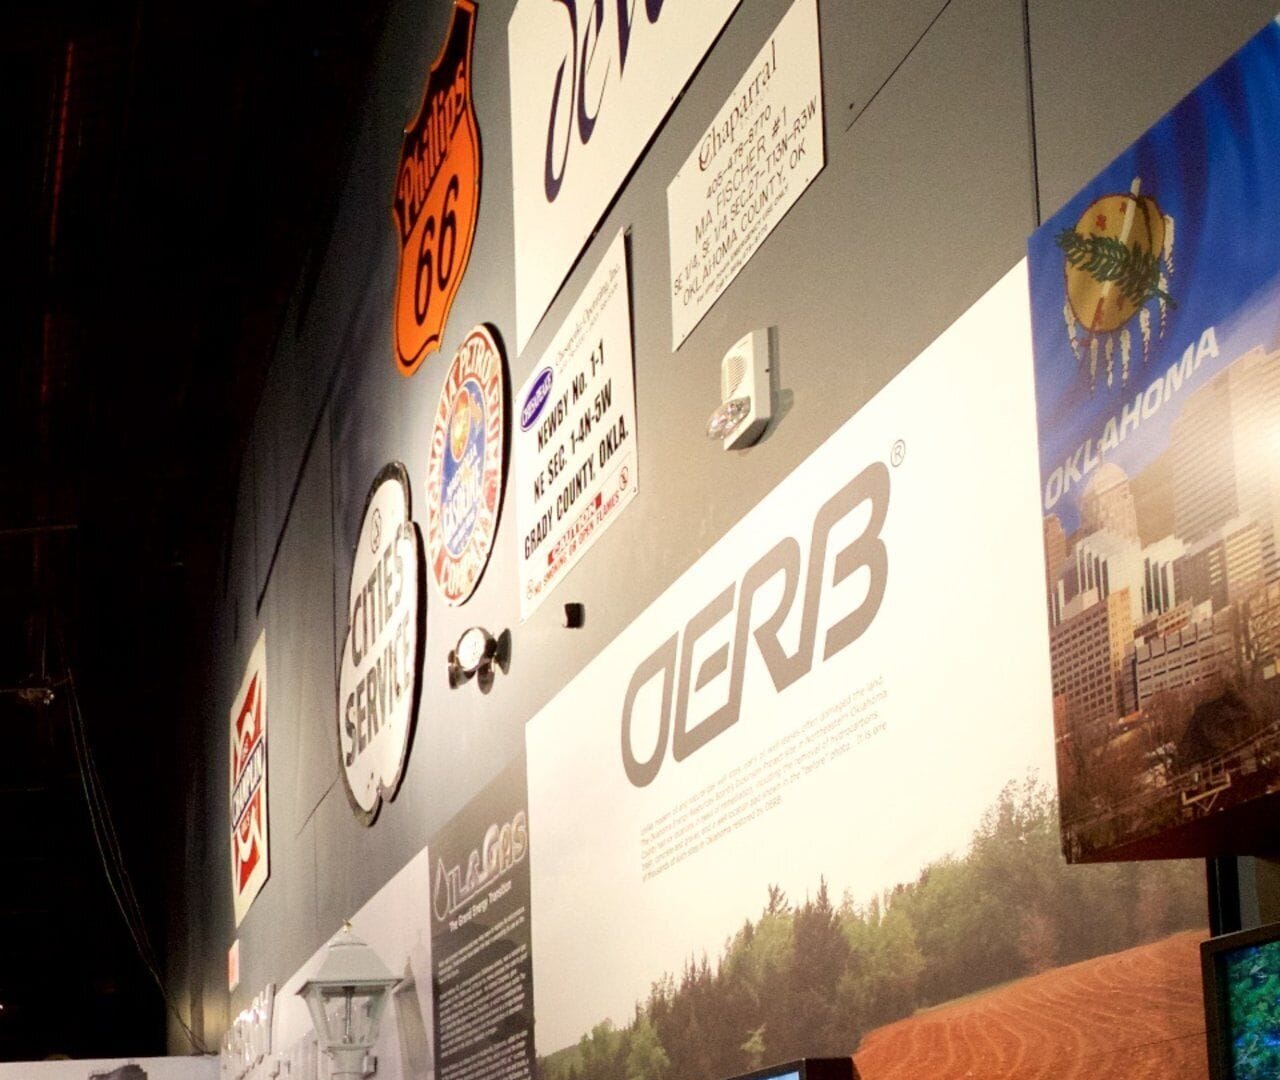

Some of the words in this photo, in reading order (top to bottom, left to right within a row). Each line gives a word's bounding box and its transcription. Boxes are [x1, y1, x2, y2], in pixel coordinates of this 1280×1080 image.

[399, 61, 465, 233] Phillips
[694, 209, 713, 245] MA
[716, 135, 767, 217] FISCHER
[772, 105, 787, 141] #1
[698, 40, 778, 173] Chaparral
[414, 173, 460, 327] 66
[683, 230, 738, 307] OKLAHOMA
[789, 138, 807, 171] OK
[533, 471, 544, 503] NE
[569, 378, 612, 455] 1-4N-5W
[536, 390, 569, 453] NEWBY
[589, 337, 604, 378] 1-1
[1044, 326, 1219, 510] OKLAHOMA
[524, 505, 553, 560] GRADY
[598, 409, 628, 468] OKLA.
[578, 520, 593, 542] OPEN
[596, 490, 619, 523] FLAMES
[351, 523, 404, 668] CITIES
[345, 610, 410, 768] SERVICE
